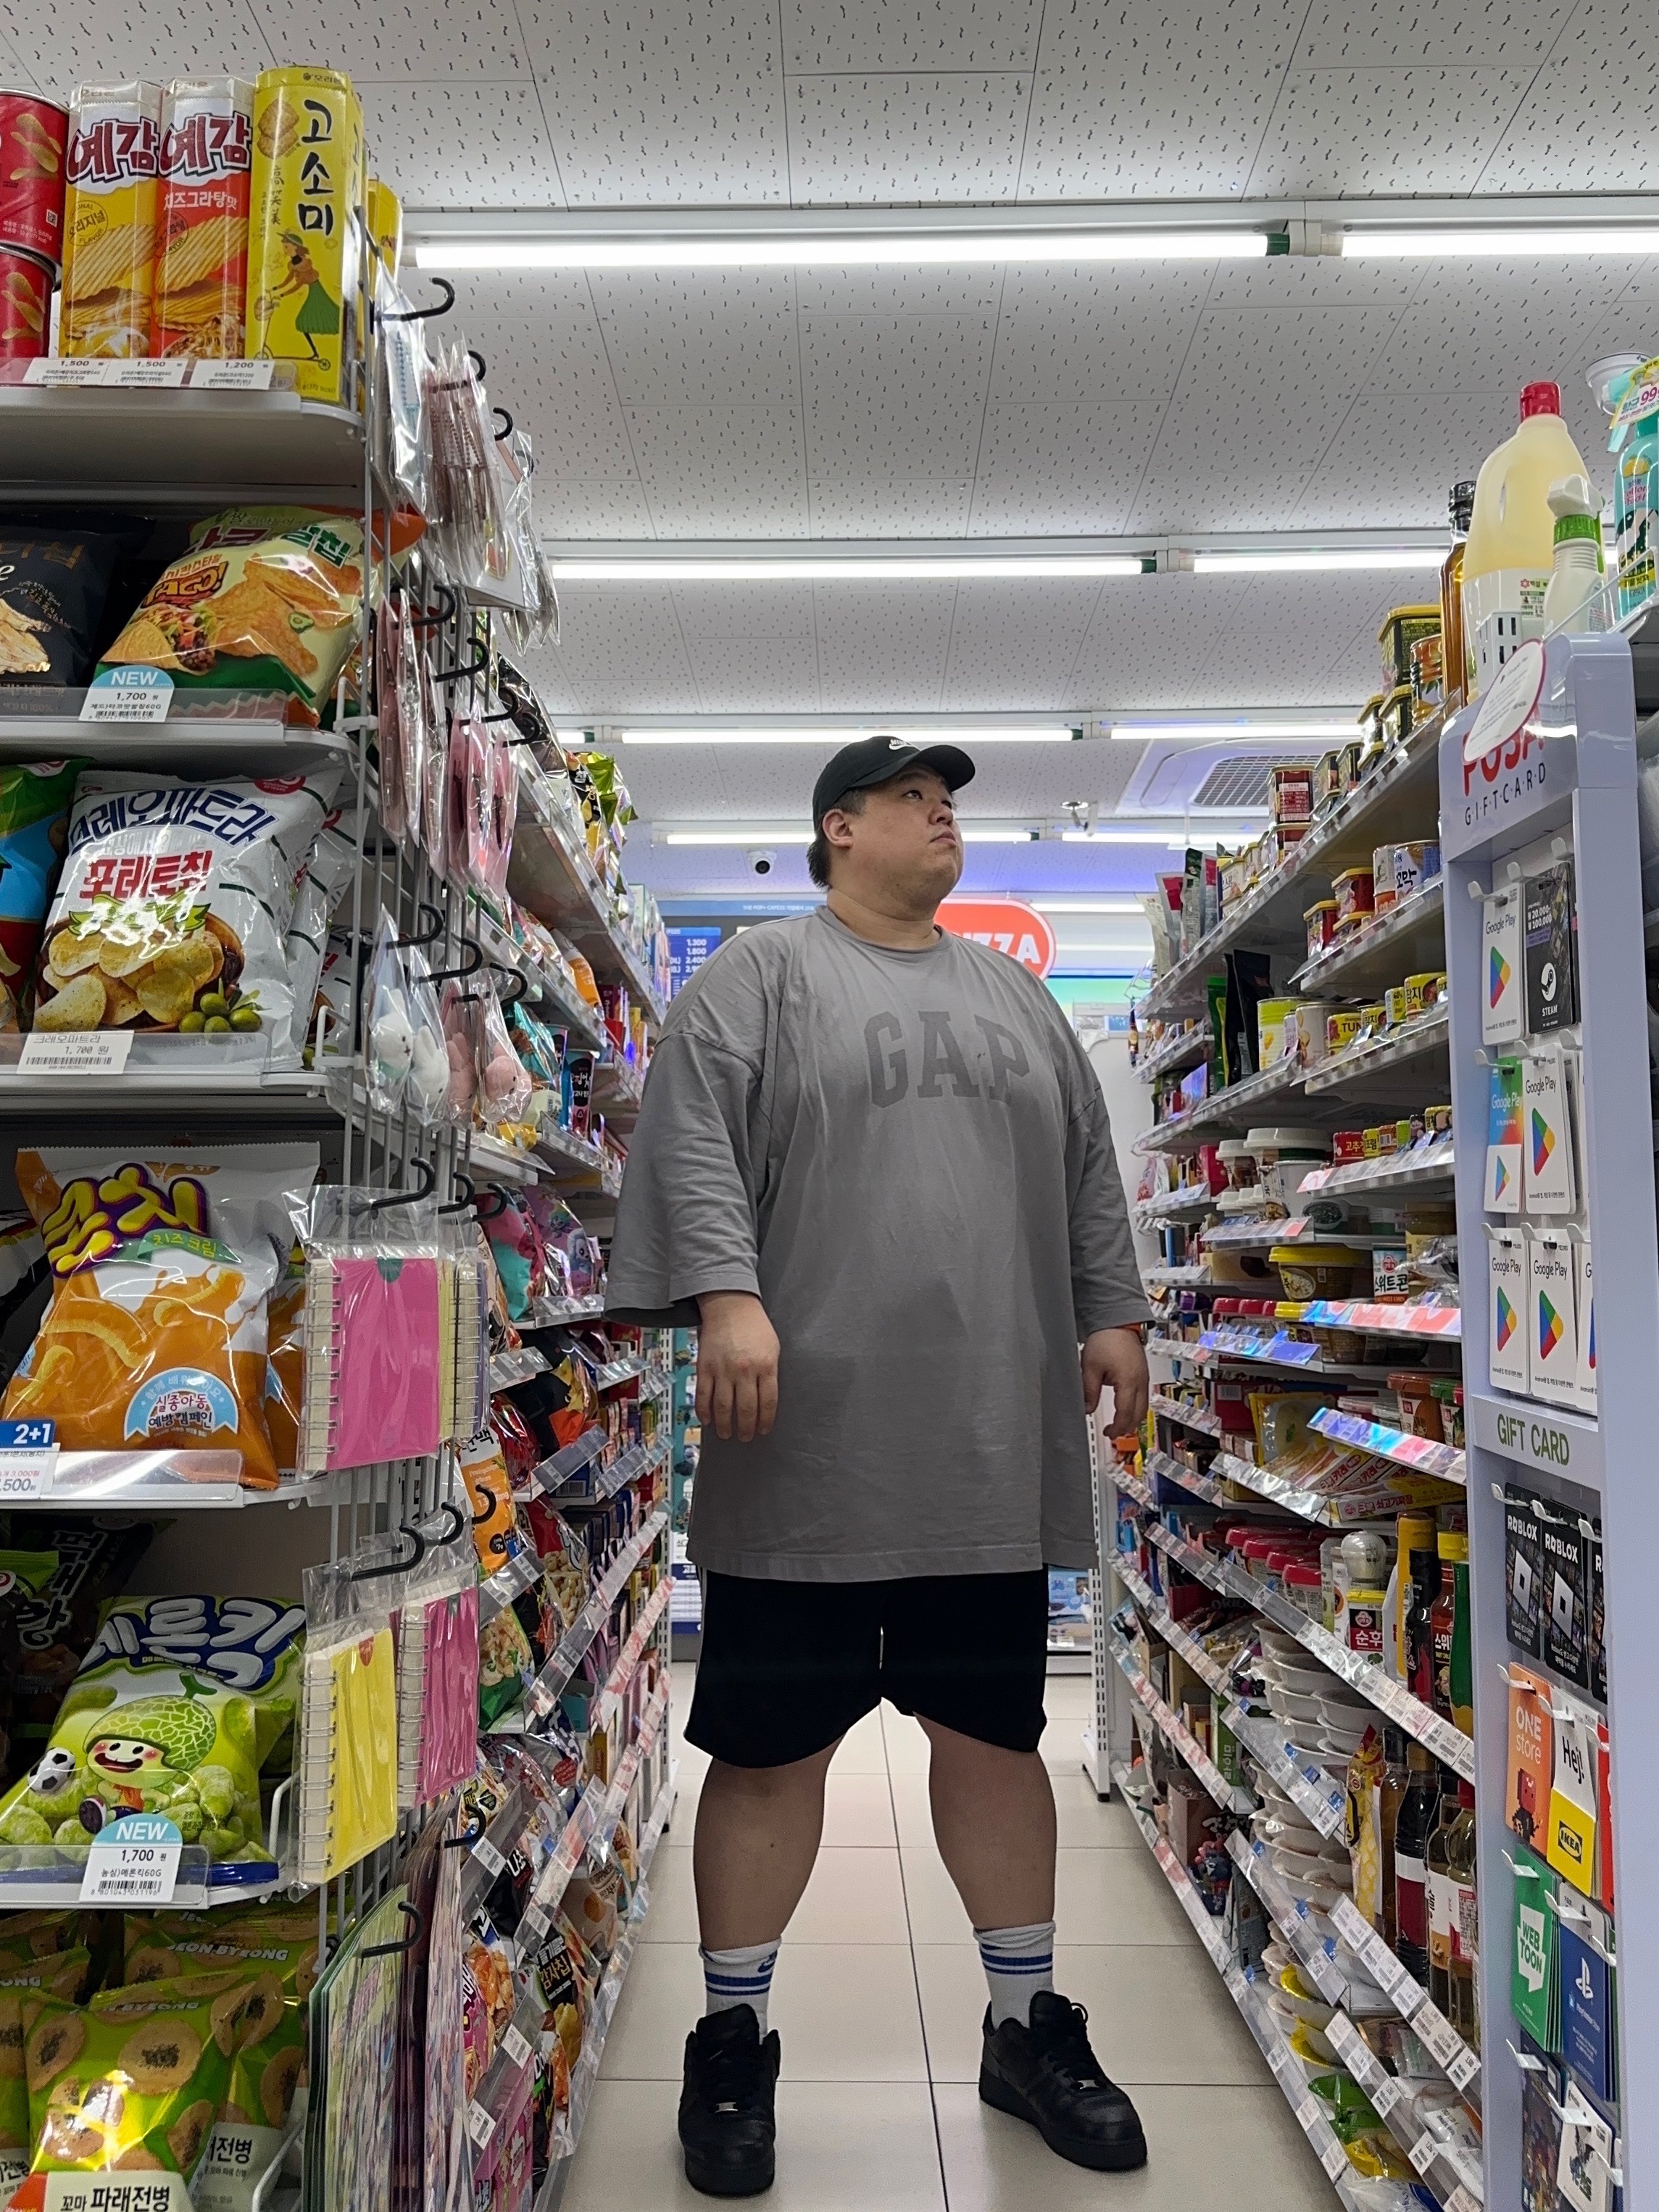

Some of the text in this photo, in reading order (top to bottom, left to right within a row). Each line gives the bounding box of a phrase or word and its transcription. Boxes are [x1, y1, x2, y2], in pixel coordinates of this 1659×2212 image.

[66, 117, 160, 183] 예감
[159, 111, 252, 178] 예감
[298, 99, 334, 236] 고소미
[111, 671, 158, 686] NEW
[116, 692, 147, 702] 1,700
[1486, 913, 1516, 935] Google Play
[1542, 1004, 1558, 1017] STEAM
[33, 1034, 101, 1044] 크레오파트라
[65, 1045, 109, 1055] 1,700 원
[863, 1010, 1031, 1110] GAP
[1526, 1076, 1557, 1097] Google Play
[1492, 1094, 1511, 1113] Google
[1492, 1257, 1521, 1277] Google Play
[1534, 1260, 1554, 1280] Google
[1555, 1261, 1567, 1281] Play
[156, 1392, 208, 1413] 실종아동
[149, 1411, 213, 1429] 예방 캠페인
[13, 1423, 51, 1444] 2+1
[1497, 1413, 1570, 1467] GIFT CARD
[1507, 1514, 1537, 1542] ROBLOX
[1544, 1532, 1578, 1564] ROBLOX
[1516, 1705, 1542, 1742] ONE
[1515, 1732, 1542, 1766] store
[1562, 1736, 1584, 1785] Hej!
[116, 1821, 170, 1841] NEW
[1560, 1826, 1582, 1853] IKEA
[121, 1849, 154, 1863] 1,700
[101, 1868, 162, 1878] 농심)메론킥60G
[1522, 1921, 1540, 1952] WEB
[1520, 1937, 1542, 1974] TOON
[91, 2185, 170, 2212] 파래전병
